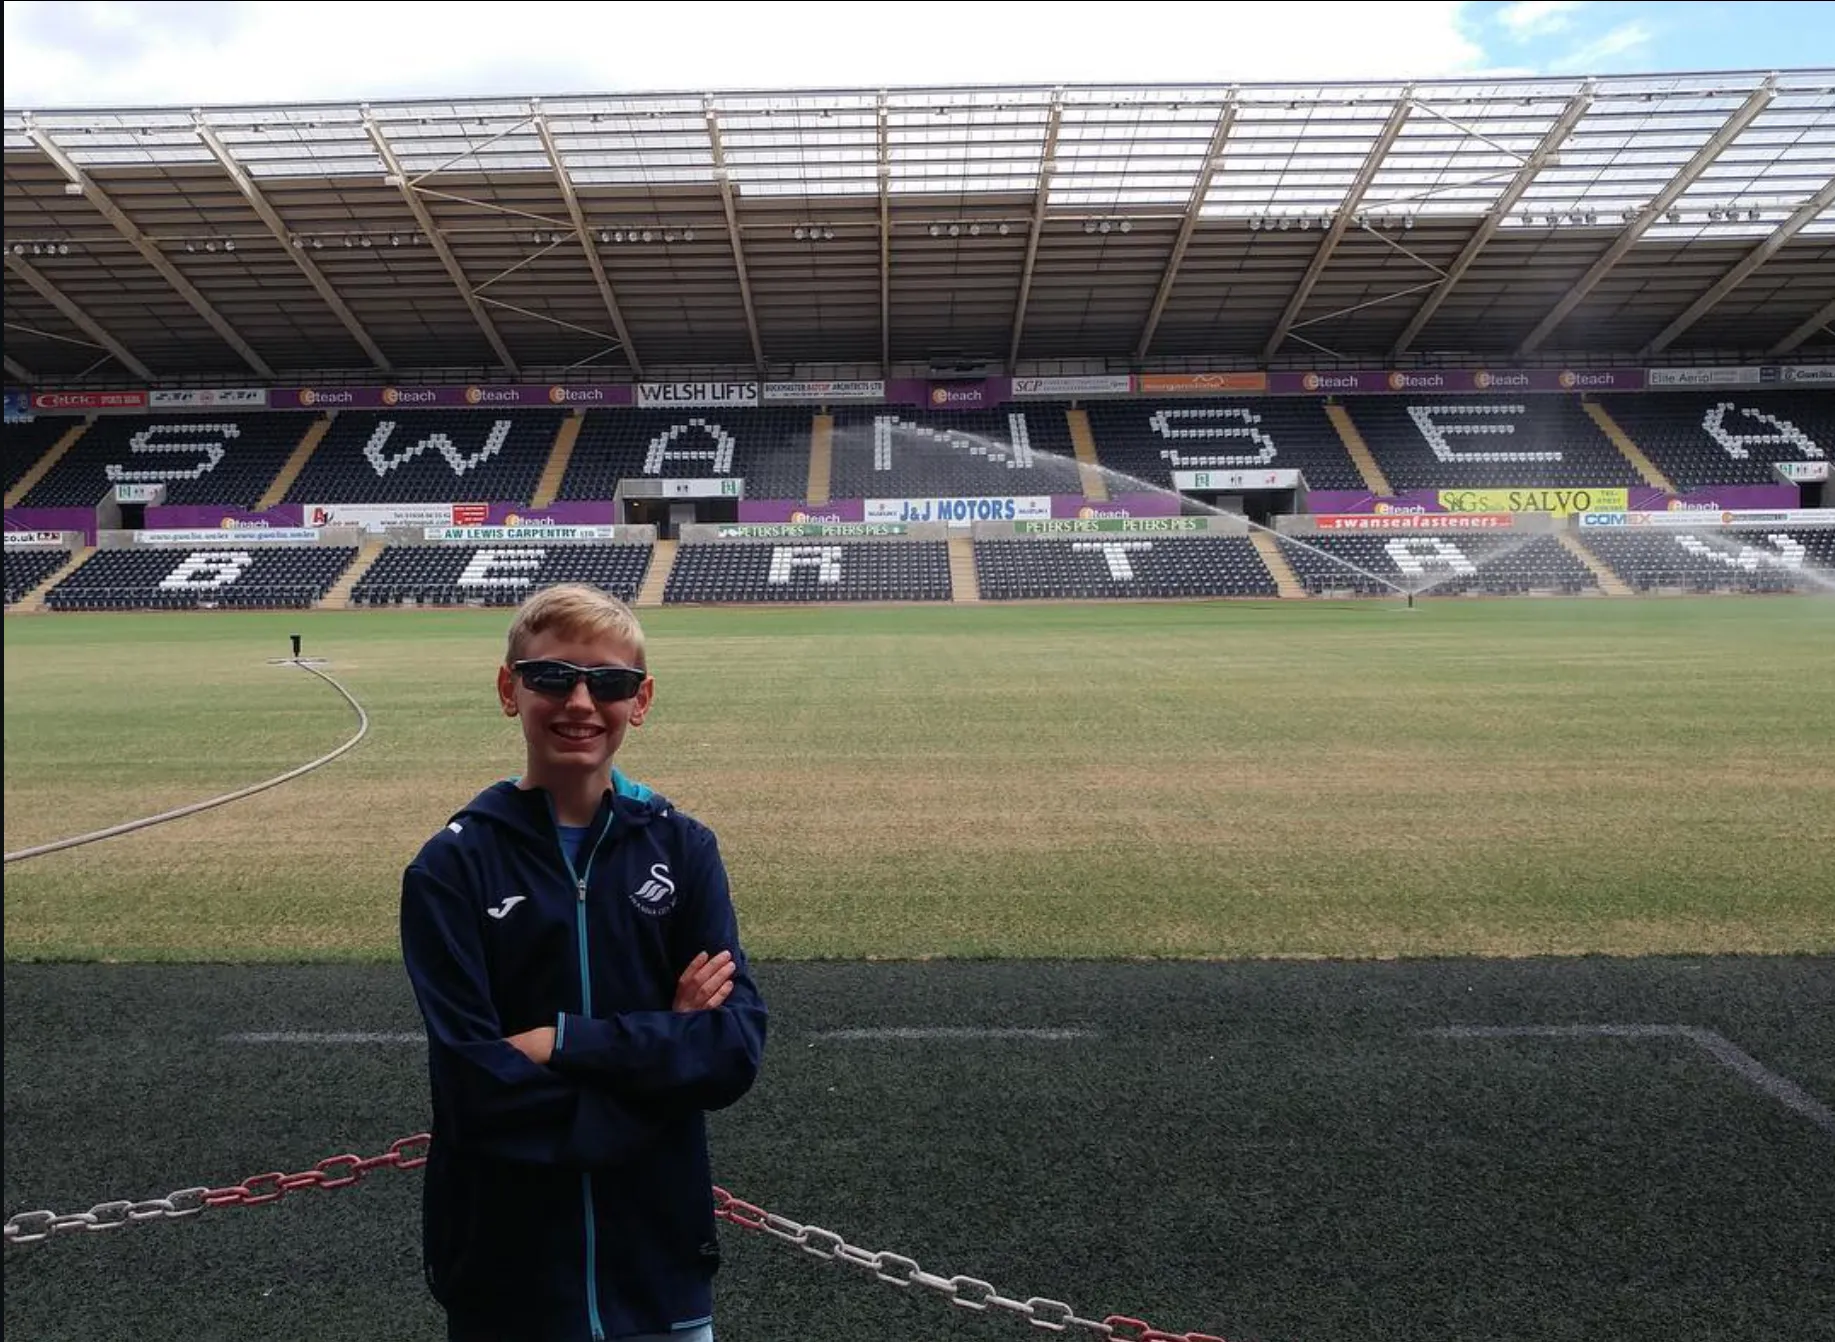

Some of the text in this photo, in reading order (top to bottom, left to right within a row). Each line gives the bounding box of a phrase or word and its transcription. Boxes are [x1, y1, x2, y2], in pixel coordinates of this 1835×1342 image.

[1310, 373, 1358, 388] eteach
[1394, 373, 1443, 386] eteach
[1480, 373, 1529, 386] eteach
[1565, 371, 1614, 384] eteach
[640, 383, 757, 400] WELSH LIFTS
[1015, 380, 1042, 392] SCP
[305, 390, 352, 402] eteach
[390, 389, 436, 402] eteach
[472, 388, 519, 401] eteach
[555, 387, 603, 400] eteach
[938, 387, 982, 401] eteach
[1509, 491, 1591, 511] SALVO
[900, 499, 1015, 521] J&J MOTORS
[738, 525, 804, 537] PETERS PIES
[822, 525, 888, 537] PETERS PIES
[1026, 521, 1099, 533] PETERS PIES
[1123, 519, 1196, 531] PETERS PIES
[445, 527, 463, 539] AW
[467, 527, 504, 539] LEWIS
[507, 526, 576, 538] CARPENTRY
